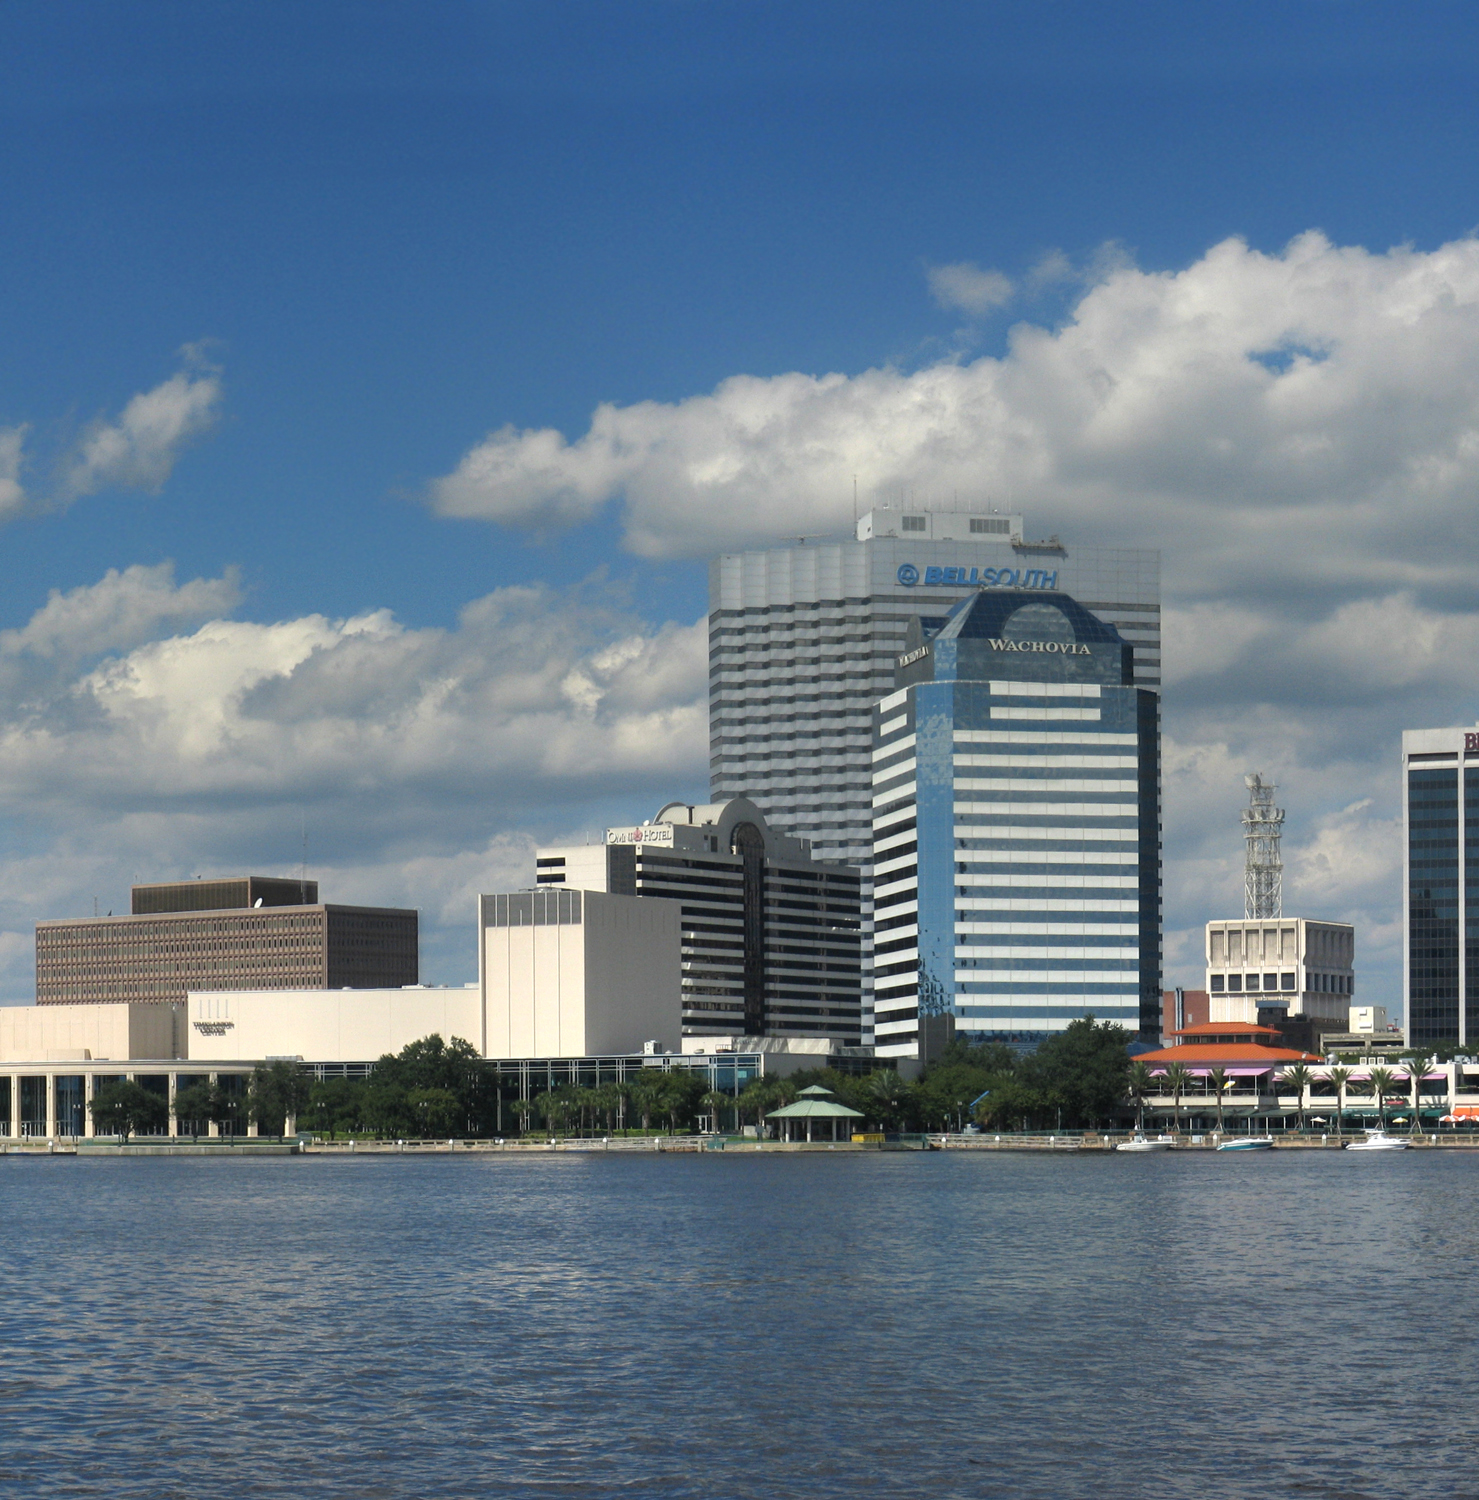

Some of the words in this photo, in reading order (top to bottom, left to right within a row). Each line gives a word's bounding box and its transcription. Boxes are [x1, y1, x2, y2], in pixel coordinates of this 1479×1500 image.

[924, 565, 1058, 589] BELLSOUTH
[988, 638, 1092, 655] WACHOVIA
[643, 830, 672, 842] HOTEL
